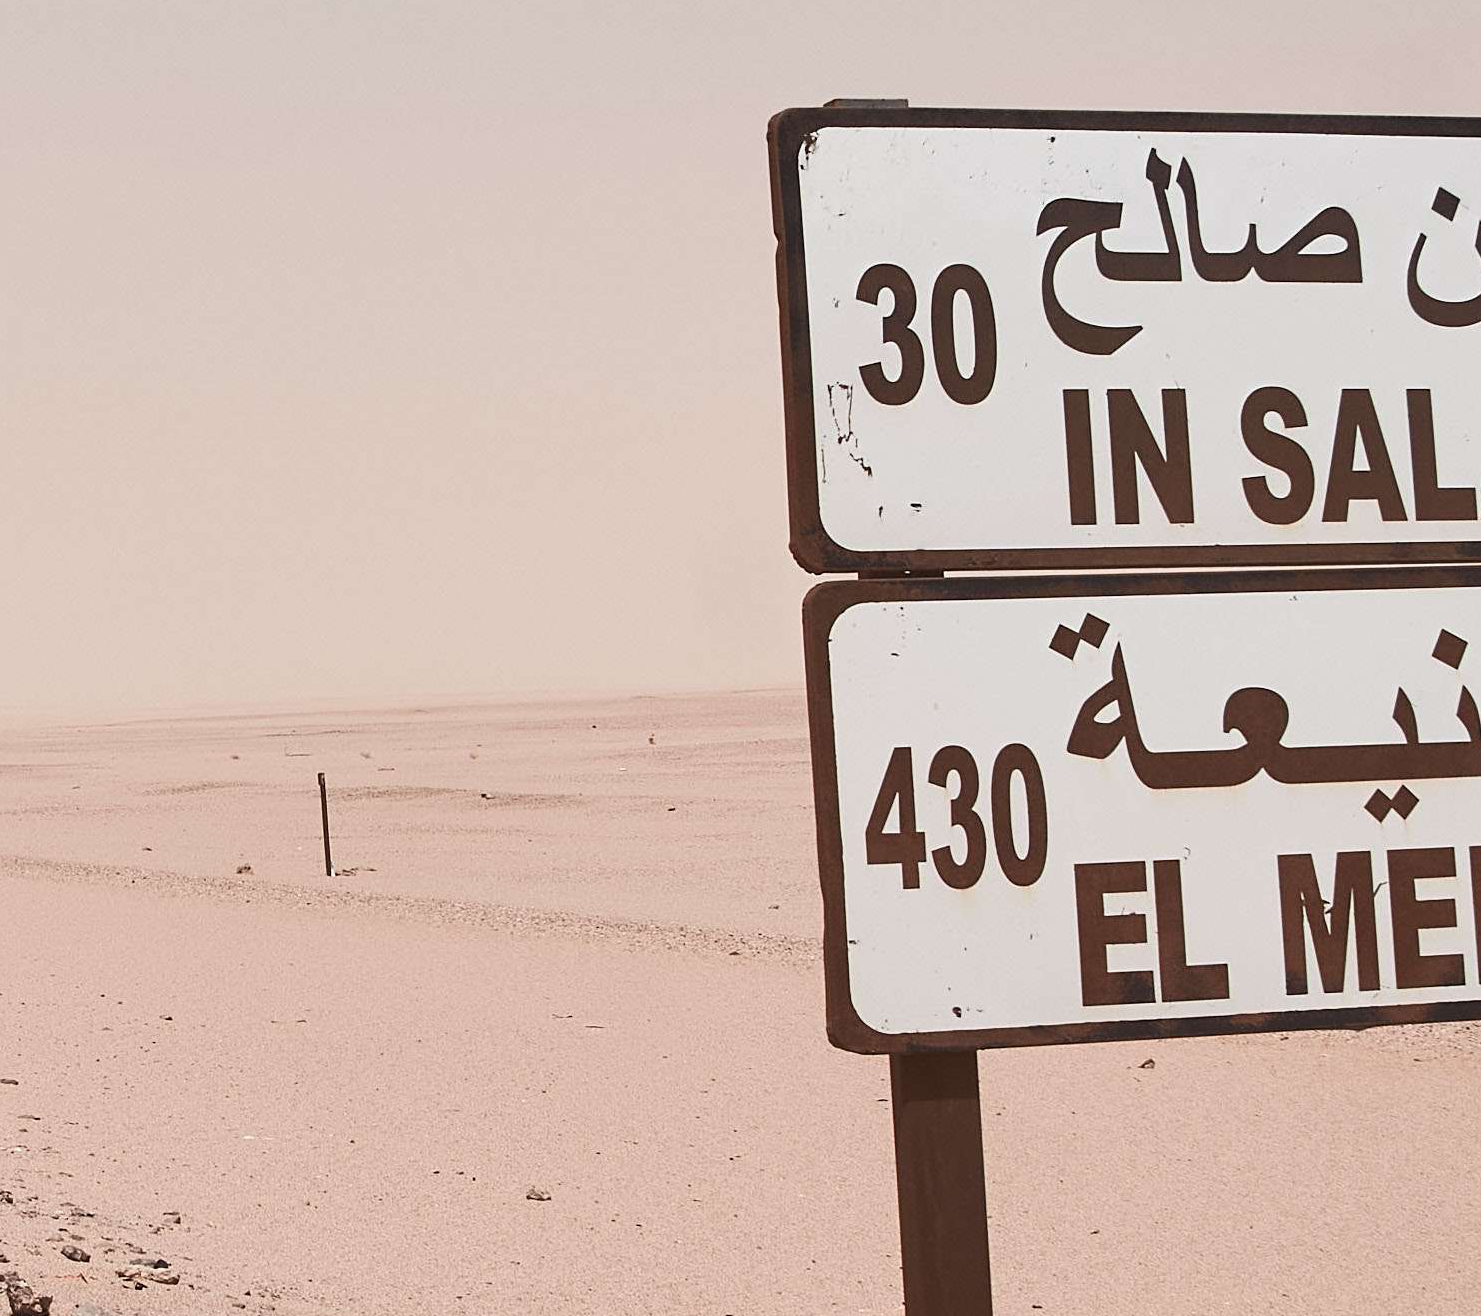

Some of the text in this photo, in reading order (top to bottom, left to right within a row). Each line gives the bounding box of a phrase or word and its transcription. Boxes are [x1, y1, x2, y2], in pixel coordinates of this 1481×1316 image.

[1035, 147, 1364, 356] صالح
[854, 263, 998, 406] 30
[1062, 387, 1195, 526] IN
[865, 742, 1049, 890] 430
[1073, 859, 1231, 1007] EL
